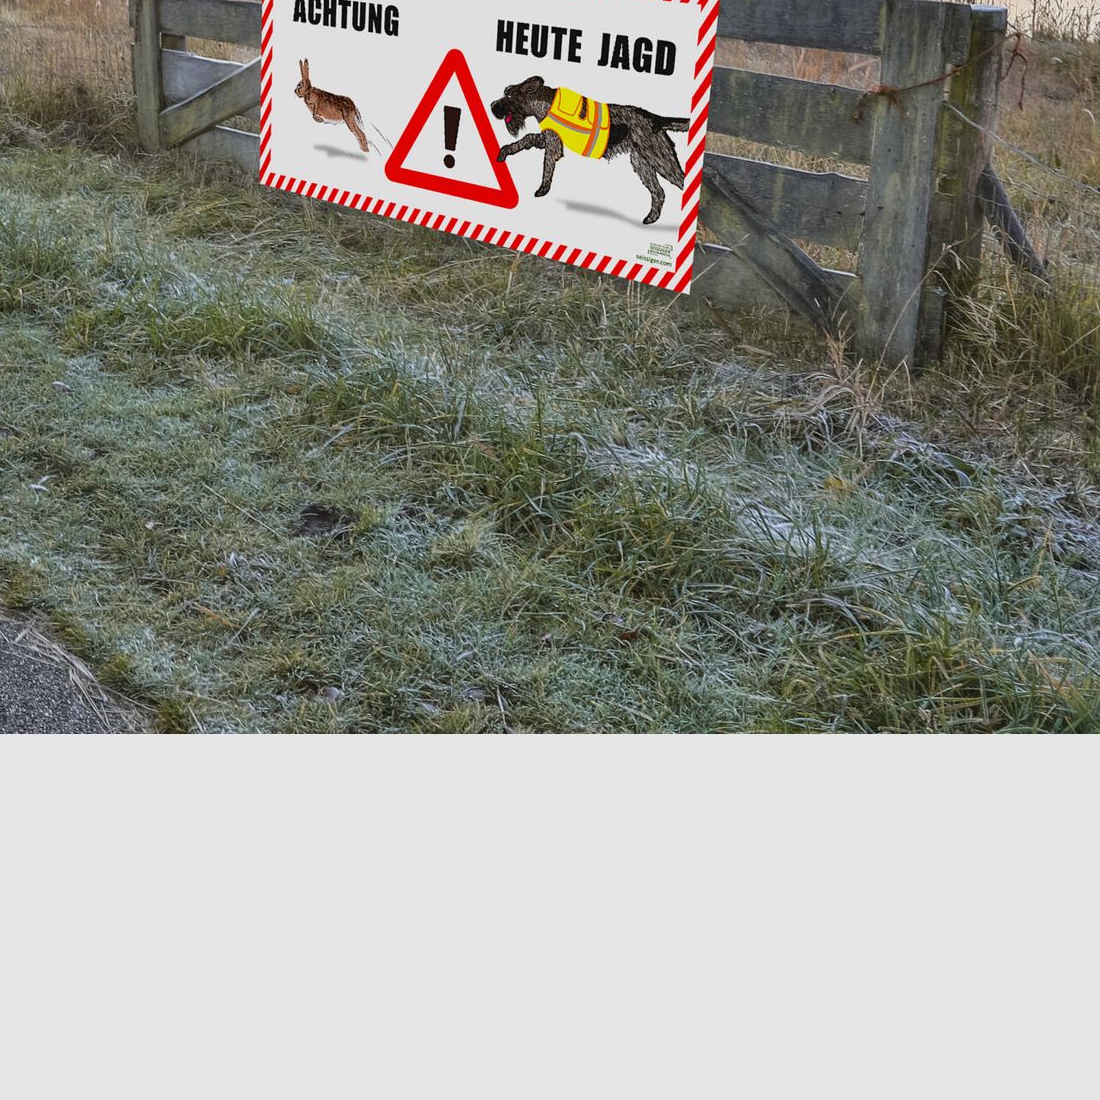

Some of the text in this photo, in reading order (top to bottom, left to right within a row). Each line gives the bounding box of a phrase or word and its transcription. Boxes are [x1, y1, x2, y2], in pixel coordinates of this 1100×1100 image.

[495, 19, 677, 76] HEUTE JAGD
[635, 253, 672, 267] seissiger.com
